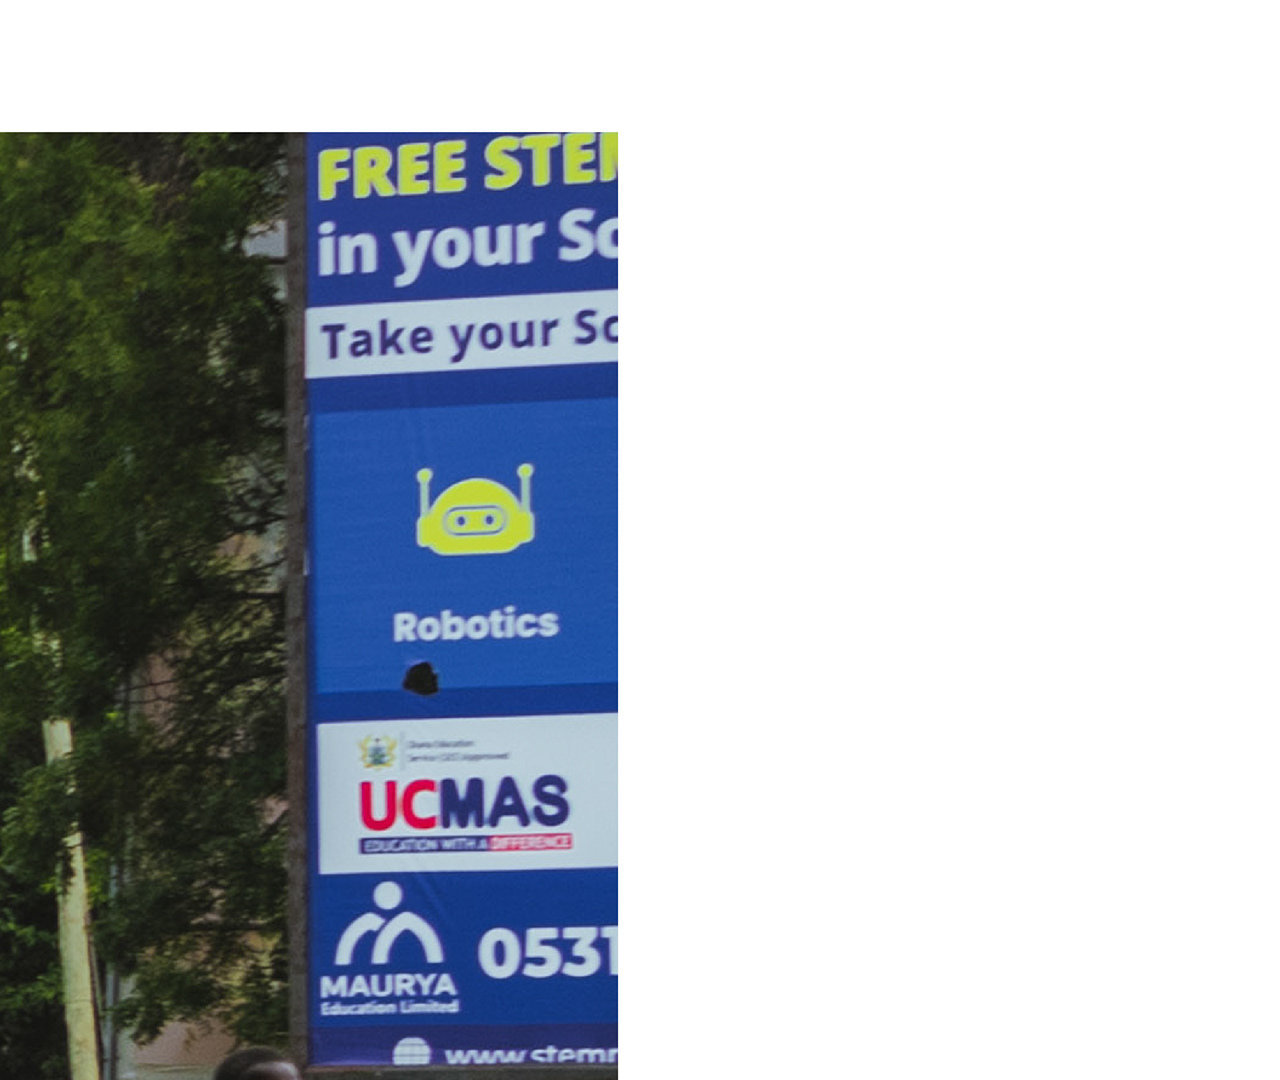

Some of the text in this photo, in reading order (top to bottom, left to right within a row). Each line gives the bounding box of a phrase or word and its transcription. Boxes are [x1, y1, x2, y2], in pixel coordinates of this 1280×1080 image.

[318, 139, 466, 201] FREE
[318, 222, 378, 276] in
[392, 221, 545, 288] your
[321, 318, 433, 359] Take
[450, 317, 558, 363] your
[393, 605, 560, 642] Robotics
[359, 774, 570, 831] UCMAS
[478, 925, 618, 979] 0531
[320, 1000, 460, 1015] Education Limited
[321, 973, 458, 998] MAURYA
